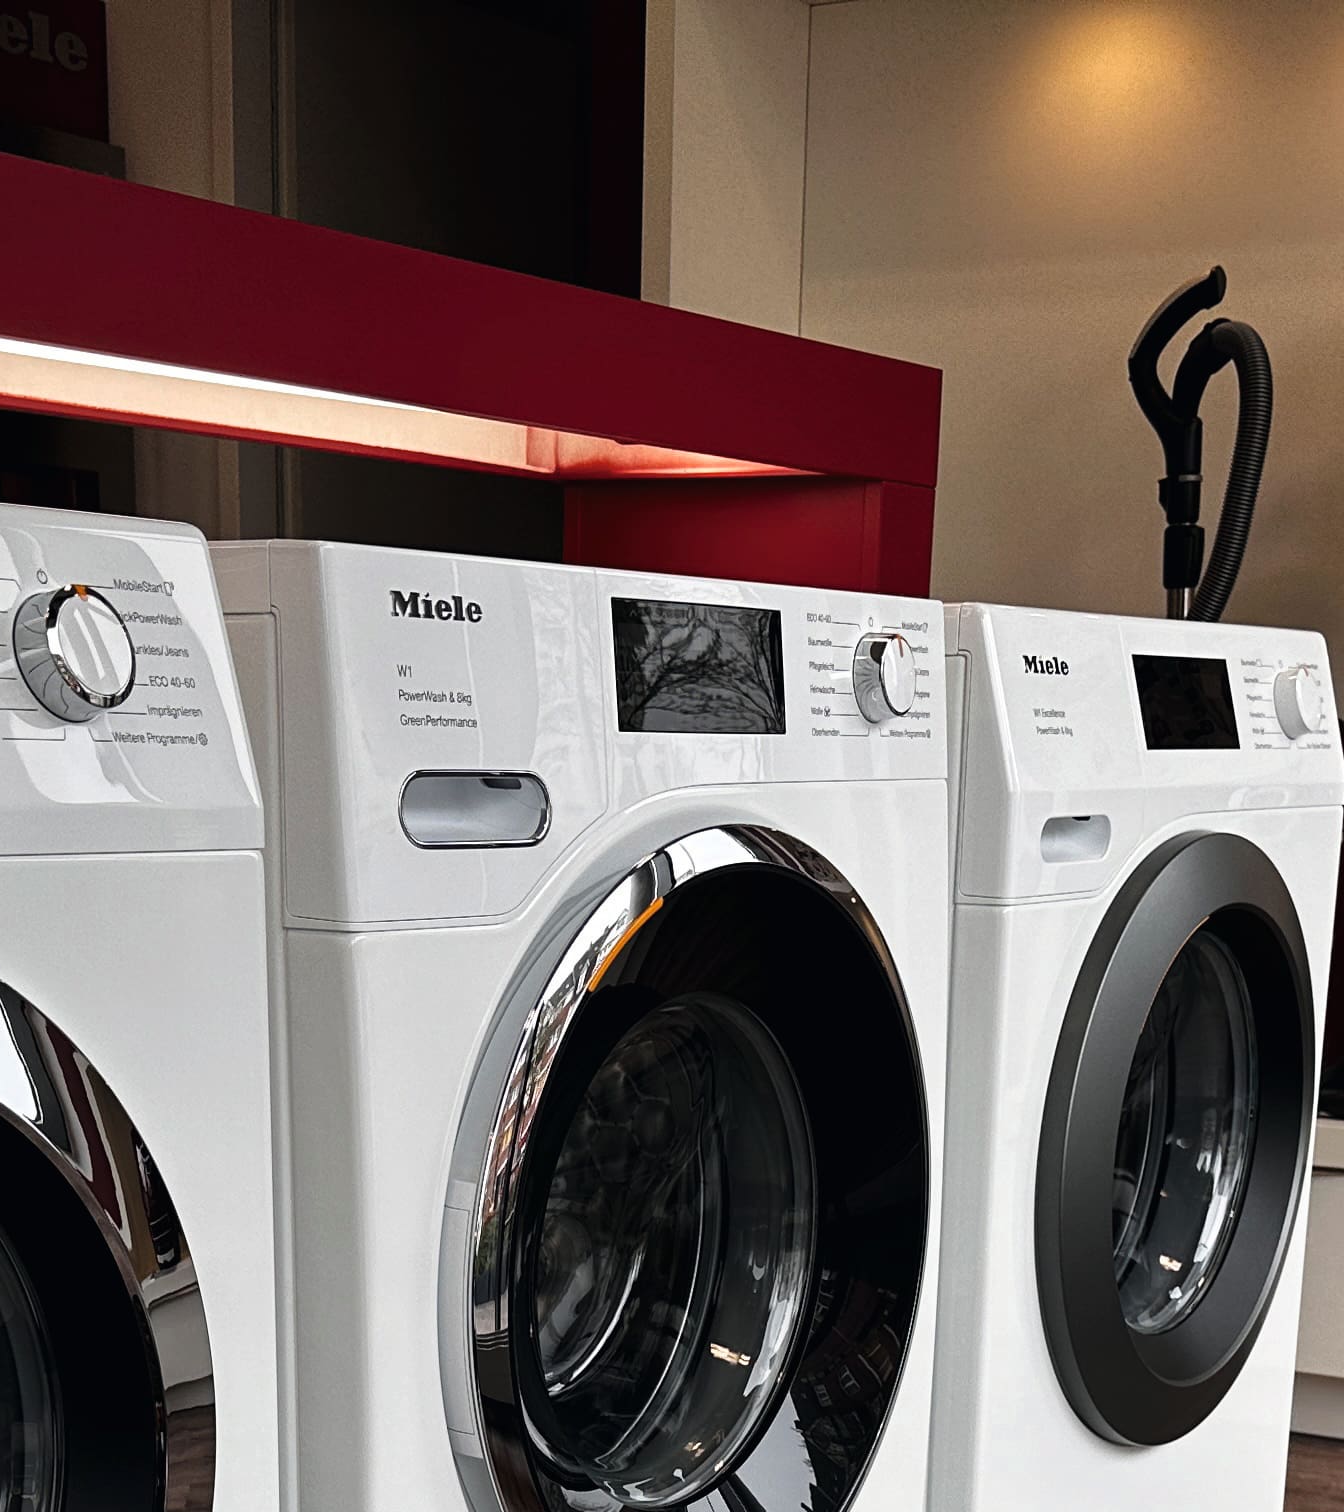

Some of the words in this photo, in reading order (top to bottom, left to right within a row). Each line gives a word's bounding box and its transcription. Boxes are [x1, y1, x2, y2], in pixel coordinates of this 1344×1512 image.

[113, 579, 164, 593] MobileStart
[389, 590, 483, 623] Miele
[397, 664, 412, 677] W1
[1022, 655, 1069, 675] Miele
[149, 676, 169, 687] ECO
[171, 677, 196, 688] 40-60
[398, 689, 447, 702] PowerWash
[449, 692, 456, 703] &
[147, 705, 203, 719] Imprägnieren
[400, 714, 478, 728] GreenPerformance
[112, 732, 145, 744] Weitere
